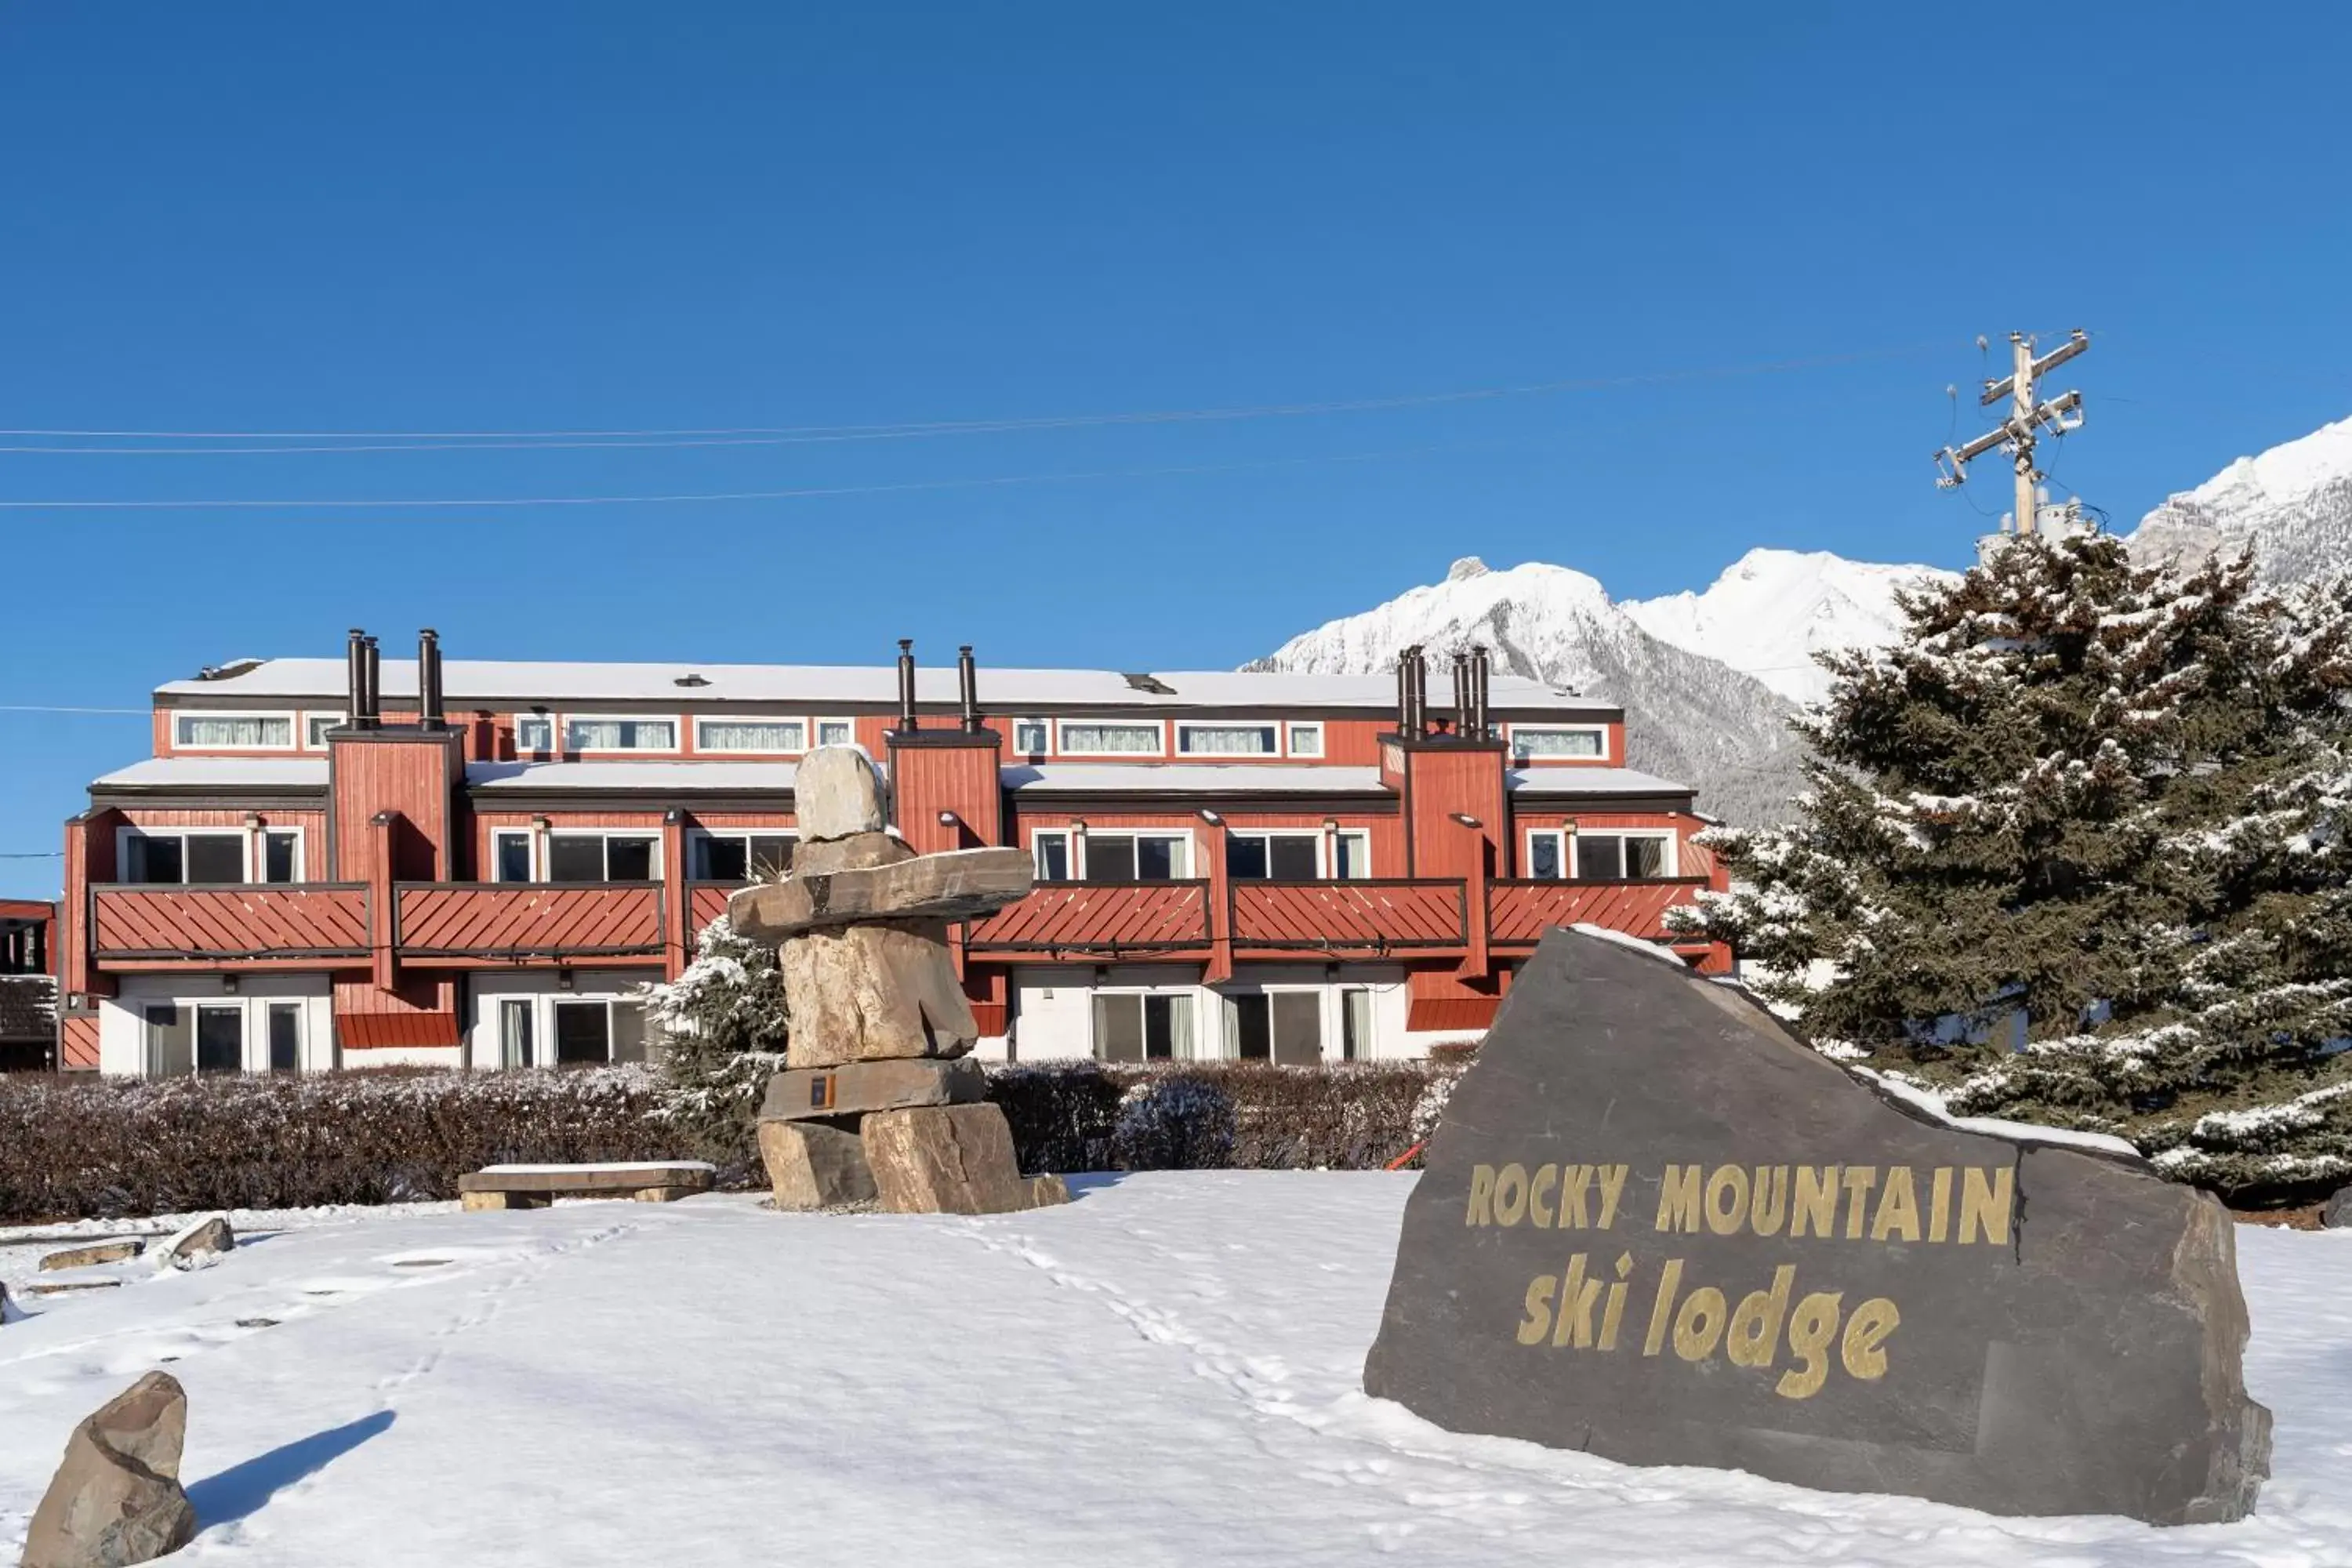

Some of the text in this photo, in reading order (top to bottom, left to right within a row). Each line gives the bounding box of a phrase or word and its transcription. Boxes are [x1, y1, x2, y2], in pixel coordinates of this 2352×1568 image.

[1465, 1163, 2013, 1245] ROCKY MOUNTAIN
[1517, 1252, 1900, 1399] ski lodge
